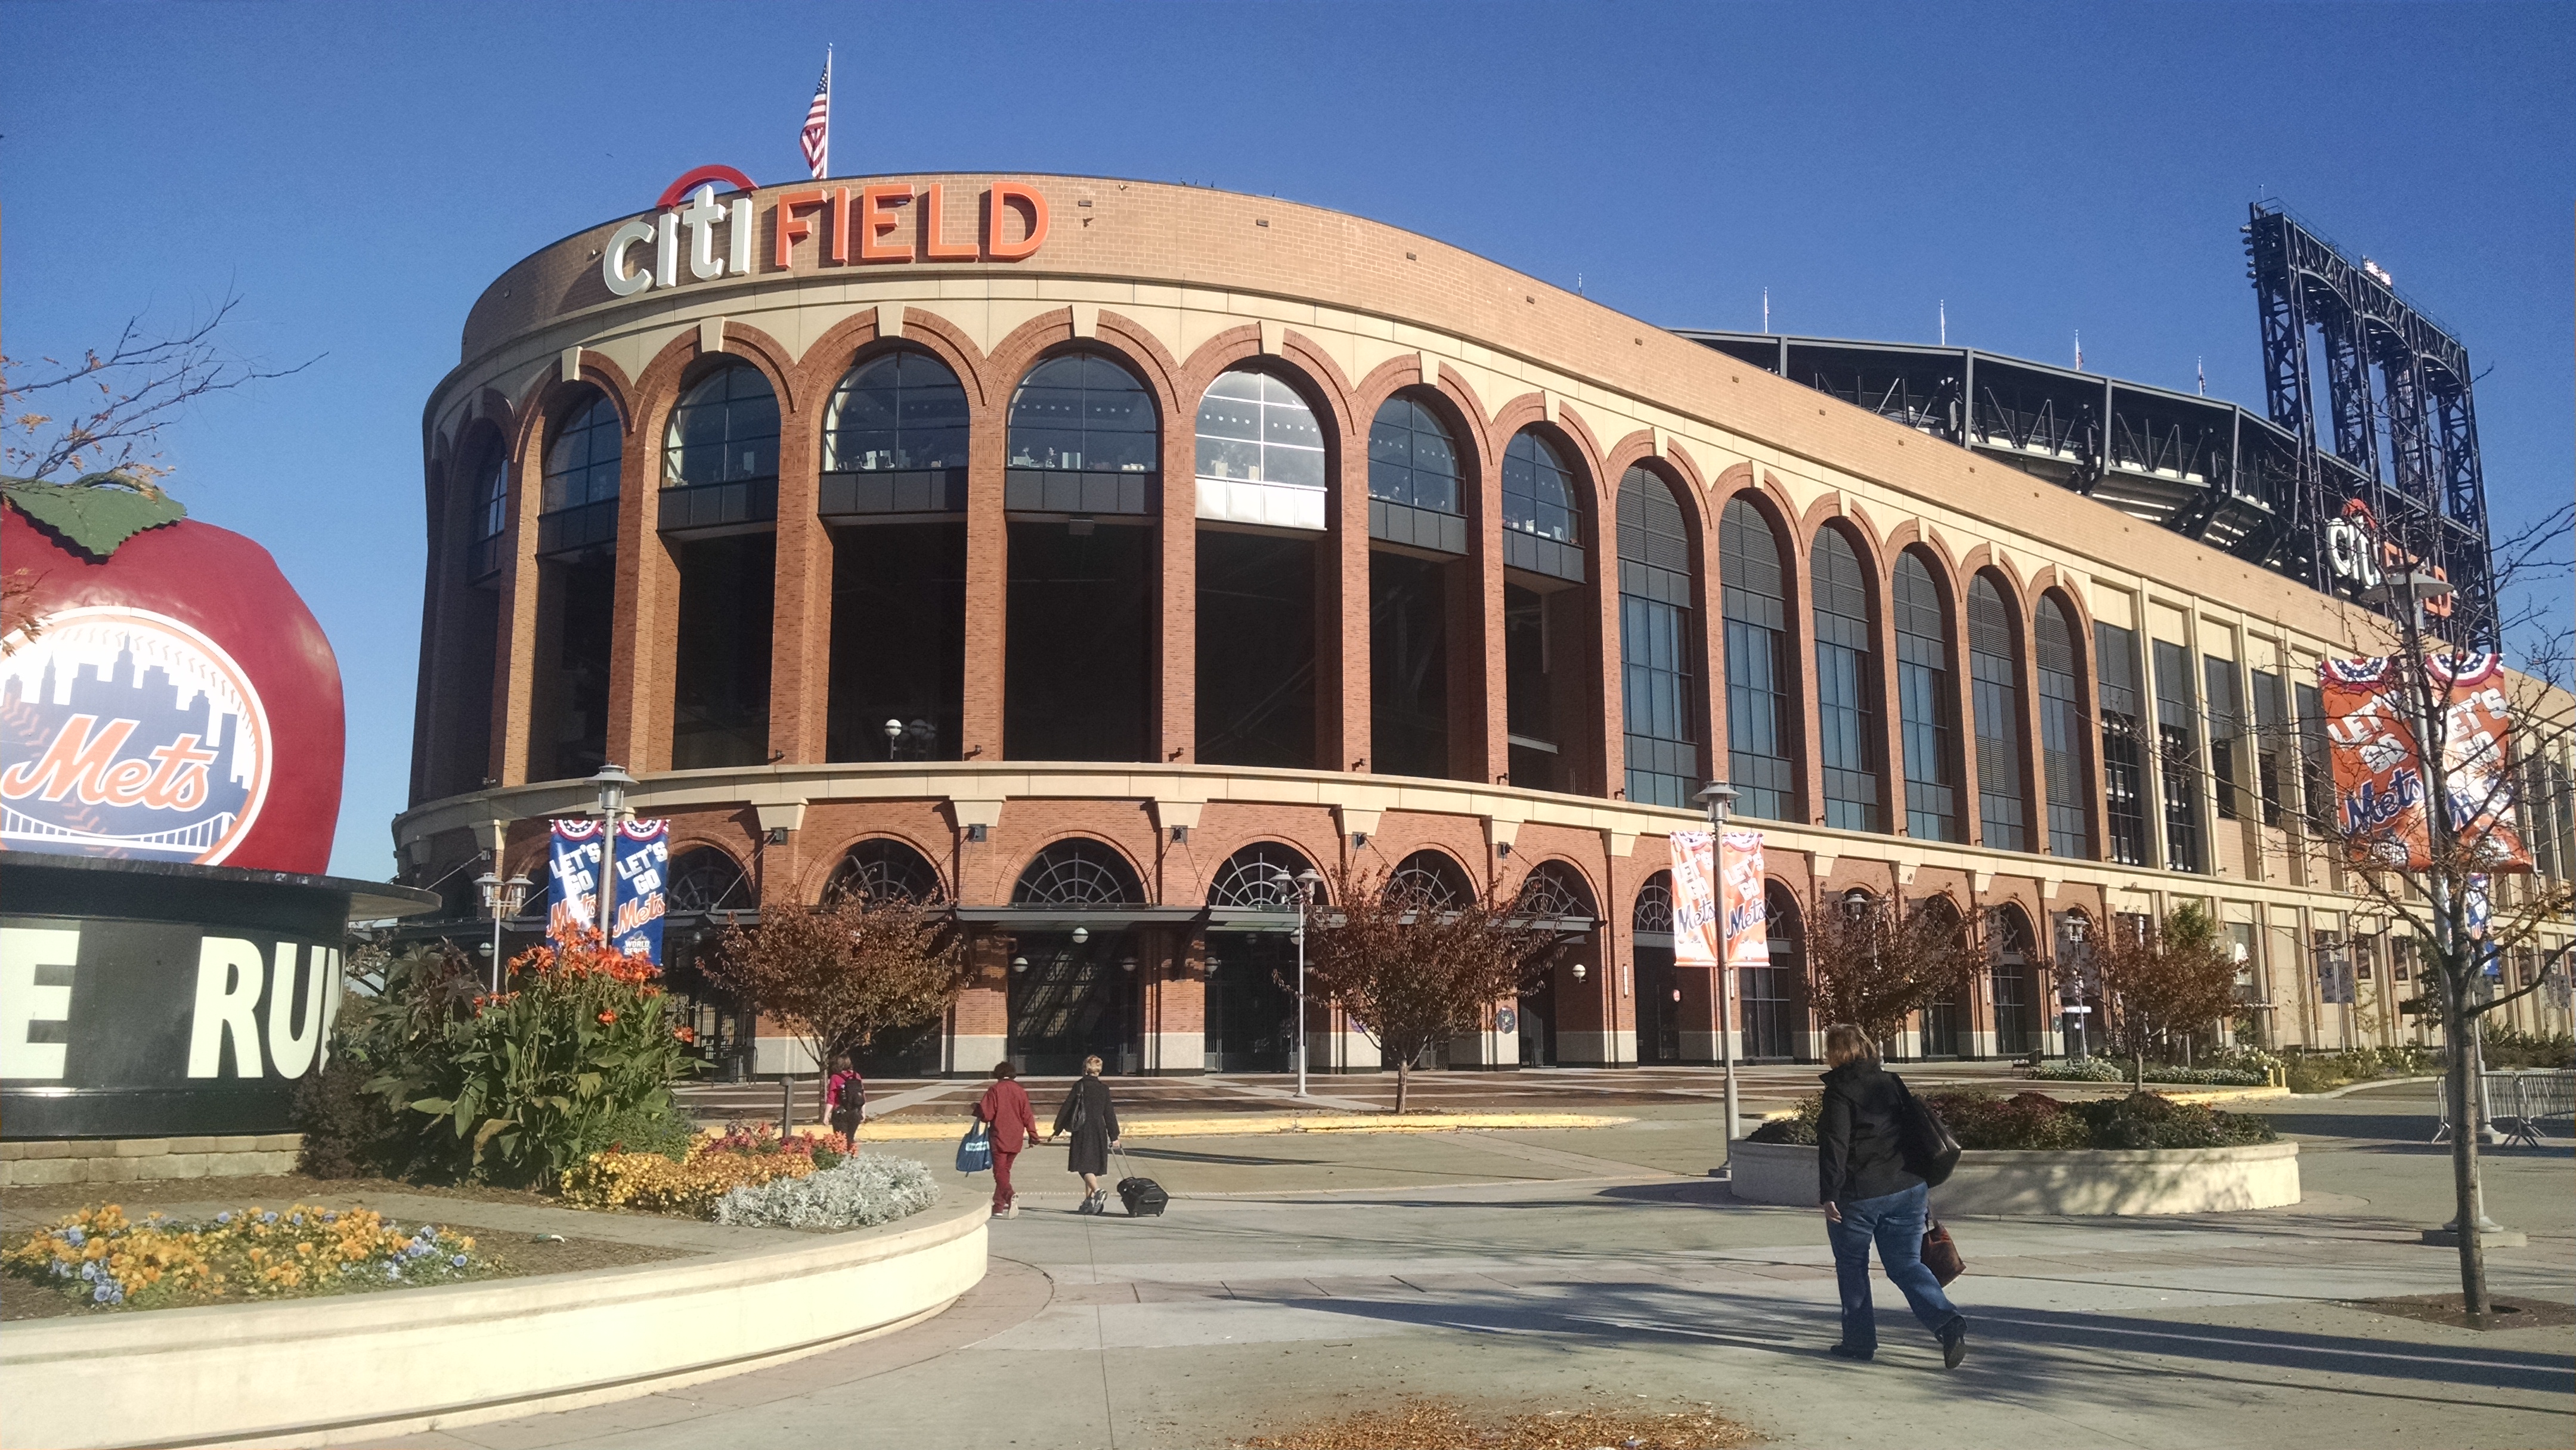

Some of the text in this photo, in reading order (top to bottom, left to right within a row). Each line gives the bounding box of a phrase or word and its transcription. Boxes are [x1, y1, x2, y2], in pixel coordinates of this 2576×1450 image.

[776, 181, 1051, 268] FIELD
[0, 713, 219, 811] Mets
[549, 842, 601, 879] LET'S
[615, 841, 668, 881] LET'S
[1671, 850, 1714, 884] LET'S
[1723, 851, 1764, 887] LET'S
[633, 868, 661, 895] GO
[1688, 876, 1710, 901] GO
[1738, 877, 1761, 901] GO
[612, 891, 665, 938] Mets
[1674, 899, 1716, 937] Mets
[1725, 898, 1766, 940] Mets
